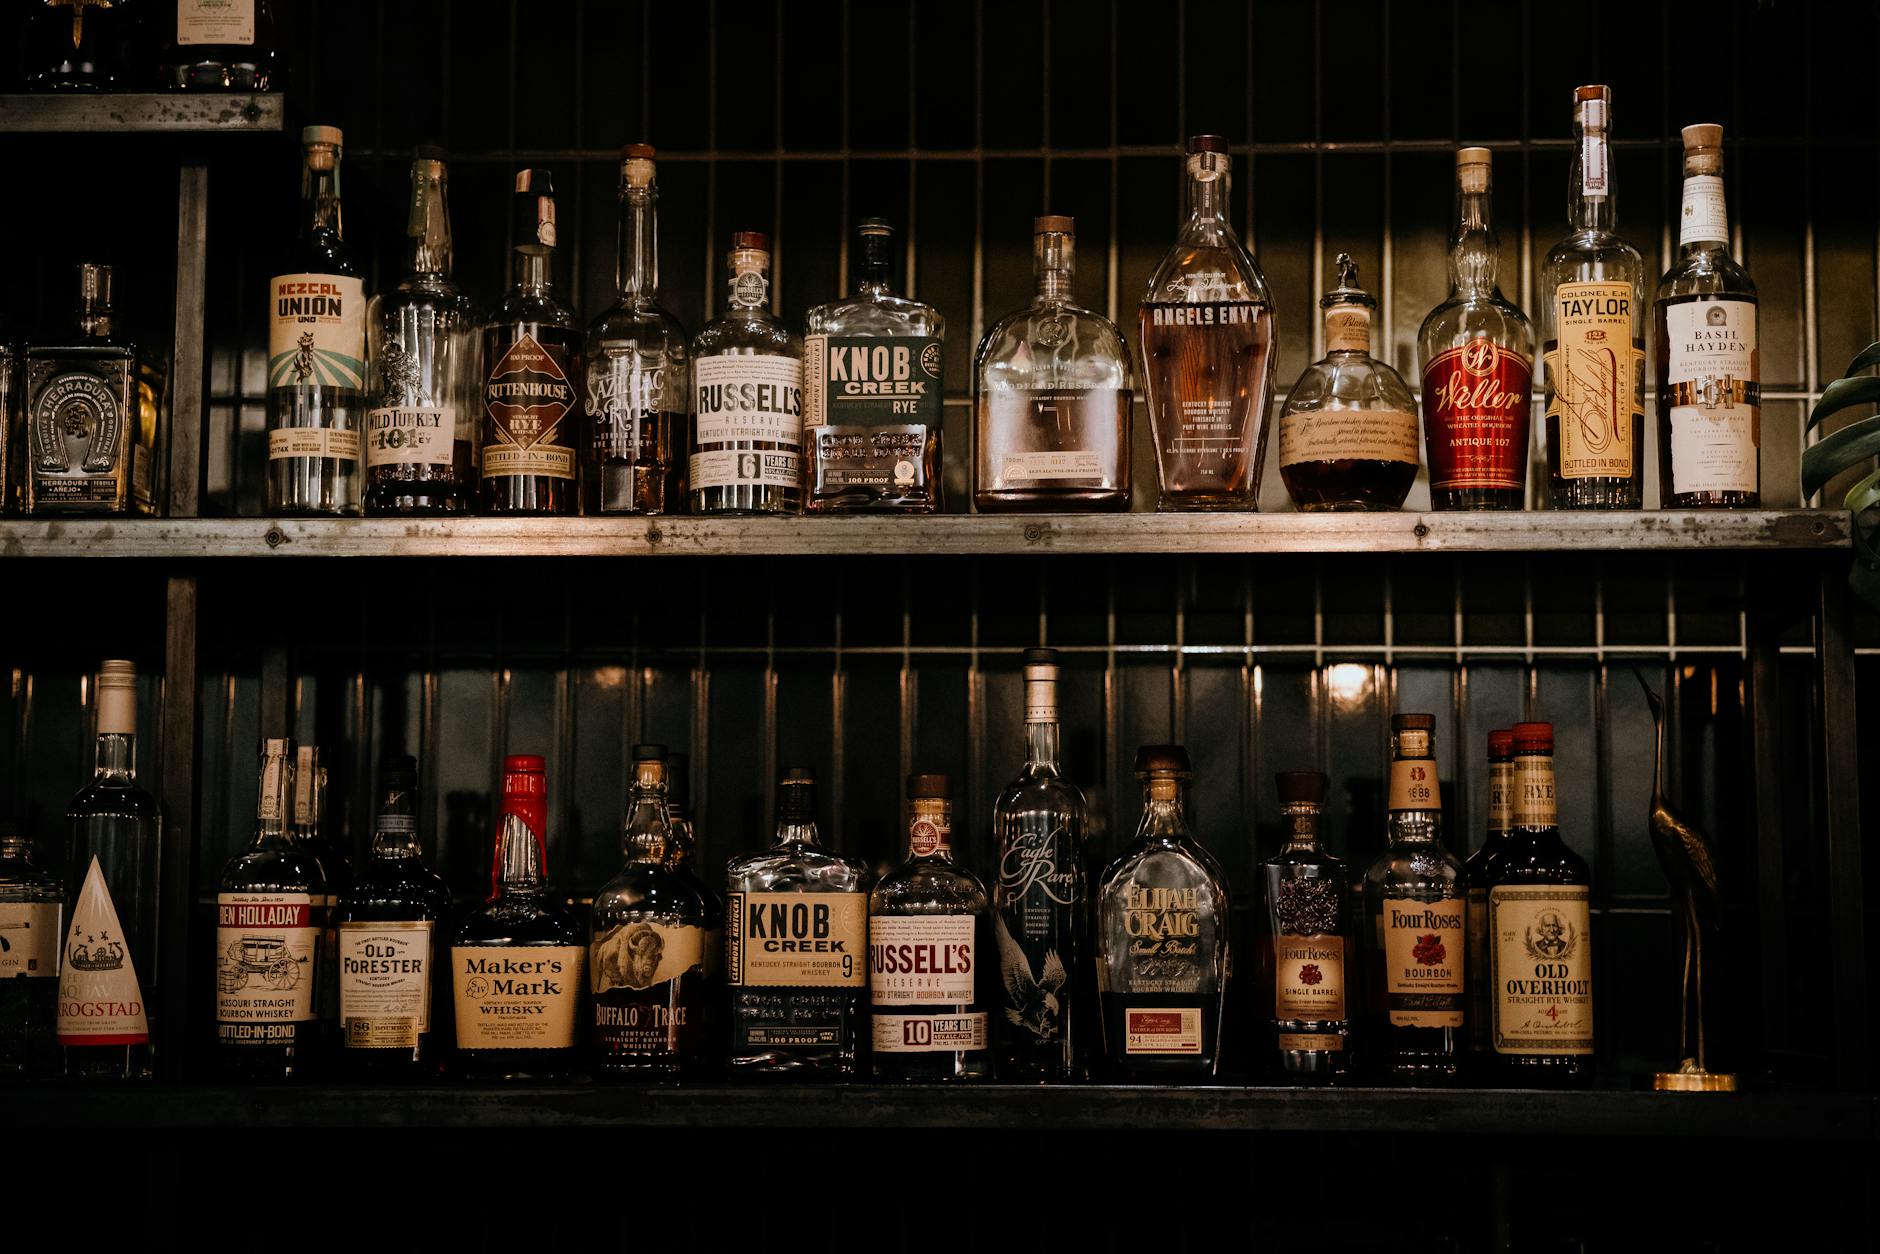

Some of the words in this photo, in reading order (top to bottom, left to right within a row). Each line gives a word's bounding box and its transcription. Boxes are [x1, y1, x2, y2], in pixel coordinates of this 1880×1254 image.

[279, 283, 342, 296] MEZCAL
[1561, 290, 1608, 299] COLONEL
[1220, 306, 1260, 325] ENVY
[1561, 298, 1629, 317] TAYLOR
[1694, 330, 1739, 341] BASIL
[1686, 342, 1745, 353] HAYDEN
[830, 346, 910, 382] KNOB
[43, 381, 112, 409] HERRADURA
[489, 382, 568, 400] RITTENHOUSE
[585, 370, 665, 416] SAZEAC
[844, 381, 926, 394] CREEK
[1435, 370, 1522, 413] Weller
[700, 383, 800, 416] RUSSELL'S
[893, 400, 917, 414] RYE
[369, 412, 390, 431] WILD
[391, 410, 441, 428] TURKEY
[509, 419, 542, 430] RYE
[726, 416, 780, 426] RESERVE
[379, 429, 419, 449] 101
[1450, 437, 1492, 447] ANTIQUE
[1495, 438, 1510, 447] 107
[546, 453, 568, 463] BOND
[742, 455, 756, 477] 6
[766, 455, 786, 467] YEARS
[1565, 459, 1596, 469] BOTTLED
[1598, 459, 1607, 468] IN
[1609, 459, 1629, 468] BOND
[1408, 787, 1430, 798] 1888
[1524, 785, 1554, 799] RYE
[1000, 828, 1060, 884] Eagle
[1007, 859, 1078, 905] Rare
[1125, 885, 1199, 910] ELIJAH
[220, 906, 235, 925] BEN
[239, 906, 300, 925] HOLLADAY
[732, 898, 740, 938] KENTUCKY
[750, 903, 829, 939] KNOB
[1391, 909, 1423, 929] Four
[1423, 910, 1462, 929] Roses
[1124, 911, 1199, 941] CRAIG
[365, 944, 395, 957] OLD
[764, 940, 846, 953] CREEK
[1129, 940, 1161, 956] Small
[1161, 940, 1198, 956] Batch
[1308, 946, 1339, 961] Roses
[344, 957, 422, 974] FORESTER
[465, 958, 562, 974] Maker's
[731, 940, 739, 981] CLERMONT,
[842, 954, 853, 978] 9
[870, 944, 971, 974] RUSSELL'S
[1404, 968, 1452, 978] BOURBON
[1535, 963, 1569, 979] OLD
[491, 979, 561, 996] Mark
[886, 979, 940, 987] RESERVE
[1507, 979, 1590, 995] OVERHOLT
[887, 991, 914, 999] STRAIGHT
[916, 991, 945, 999] BOURBON
[947, 990, 972, 999] WHISKEY
[1507, 996, 1545, 1004] STRAIGHT
[1547, 996, 1562, 1004] RYE
[253, 999, 295, 1008] STRAIGHT
[480, 1006, 546, 1015] WHISKY
[220, 1009, 252, 1018] BOURBON
[256, 1009, 295, 1018] WHISKEY
[596, 1003, 638, 1026] BUFFALO
[652, 1004, 686, 1028] TRACE
[1545, 1004, 1559, 1021] 4
[353, 1021, 370, 1031] 86
[905, 1022, 929, 1044] 10
[934, 1020, 959, 1031] YEARS
[960, 1019, 972, 1031] OLD
[1129, 1035, 1141, 1043] 94
